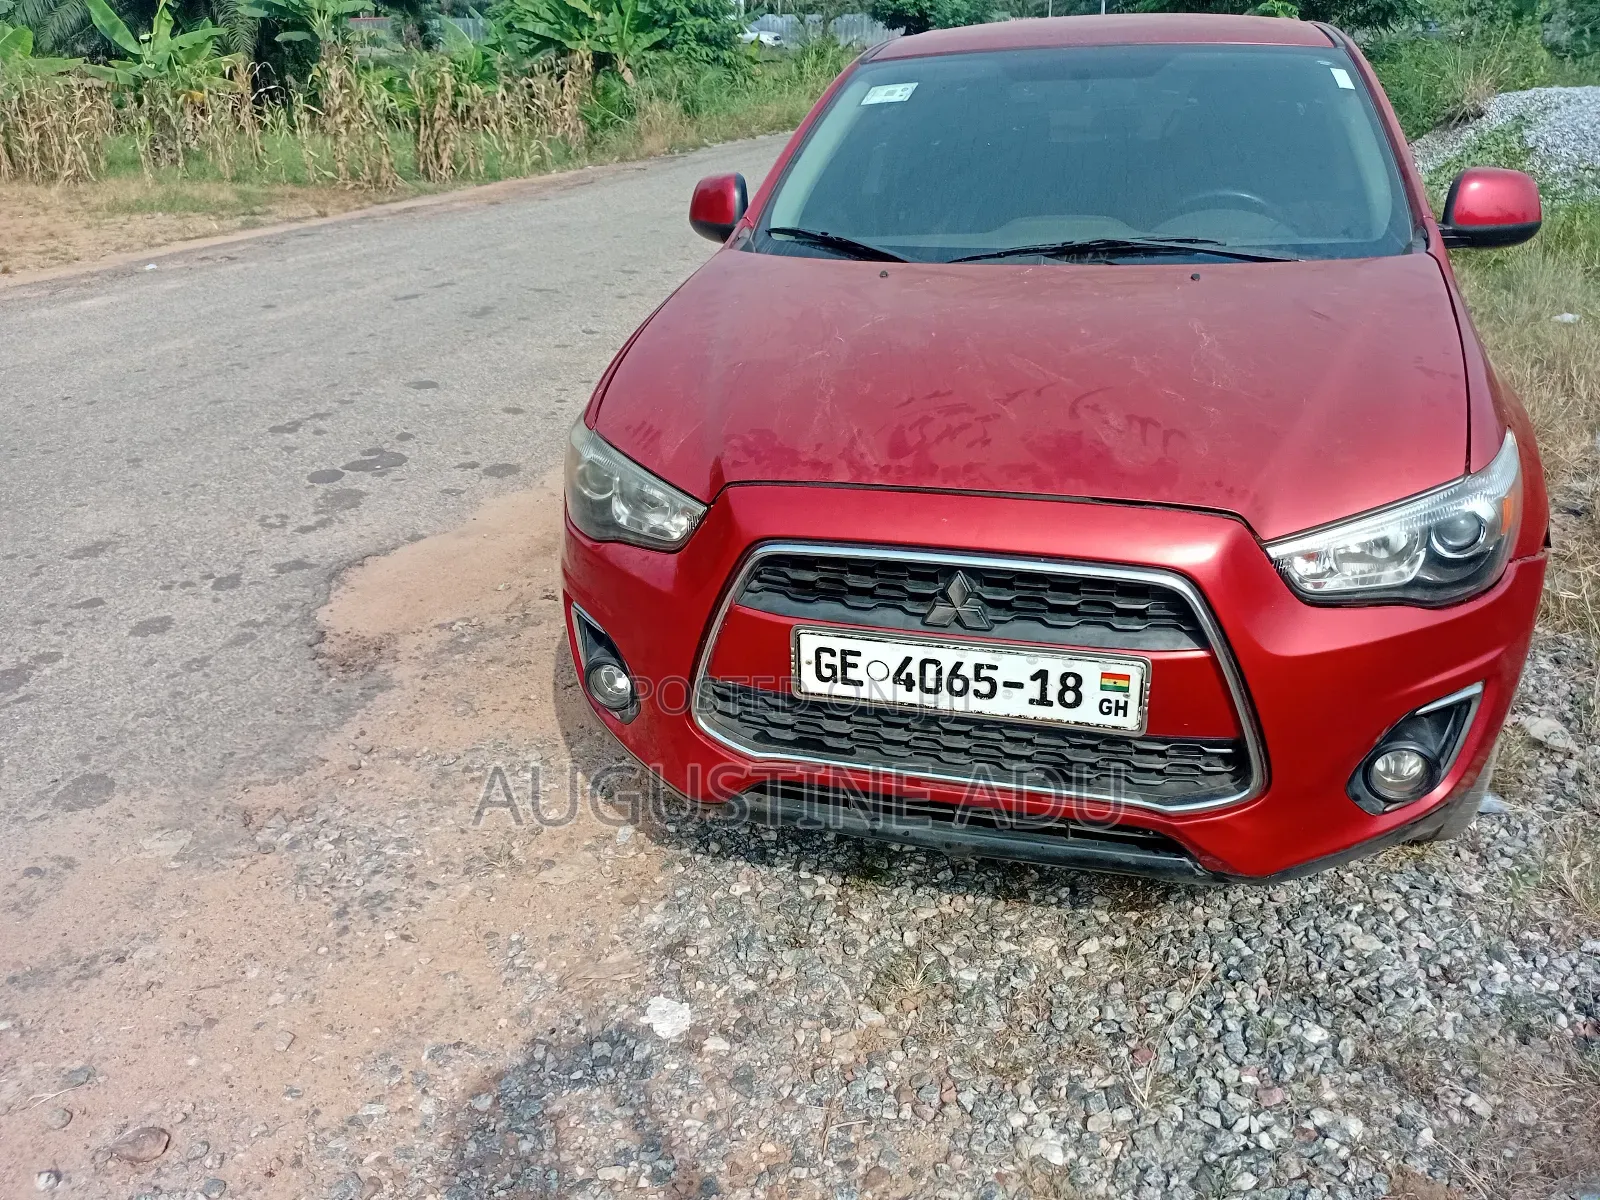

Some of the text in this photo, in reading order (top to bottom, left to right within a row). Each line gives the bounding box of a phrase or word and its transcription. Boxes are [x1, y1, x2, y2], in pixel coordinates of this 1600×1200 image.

[814, 647, 1083, 708] GE 4065-18
[1098, 698, 1128, 717] GH
